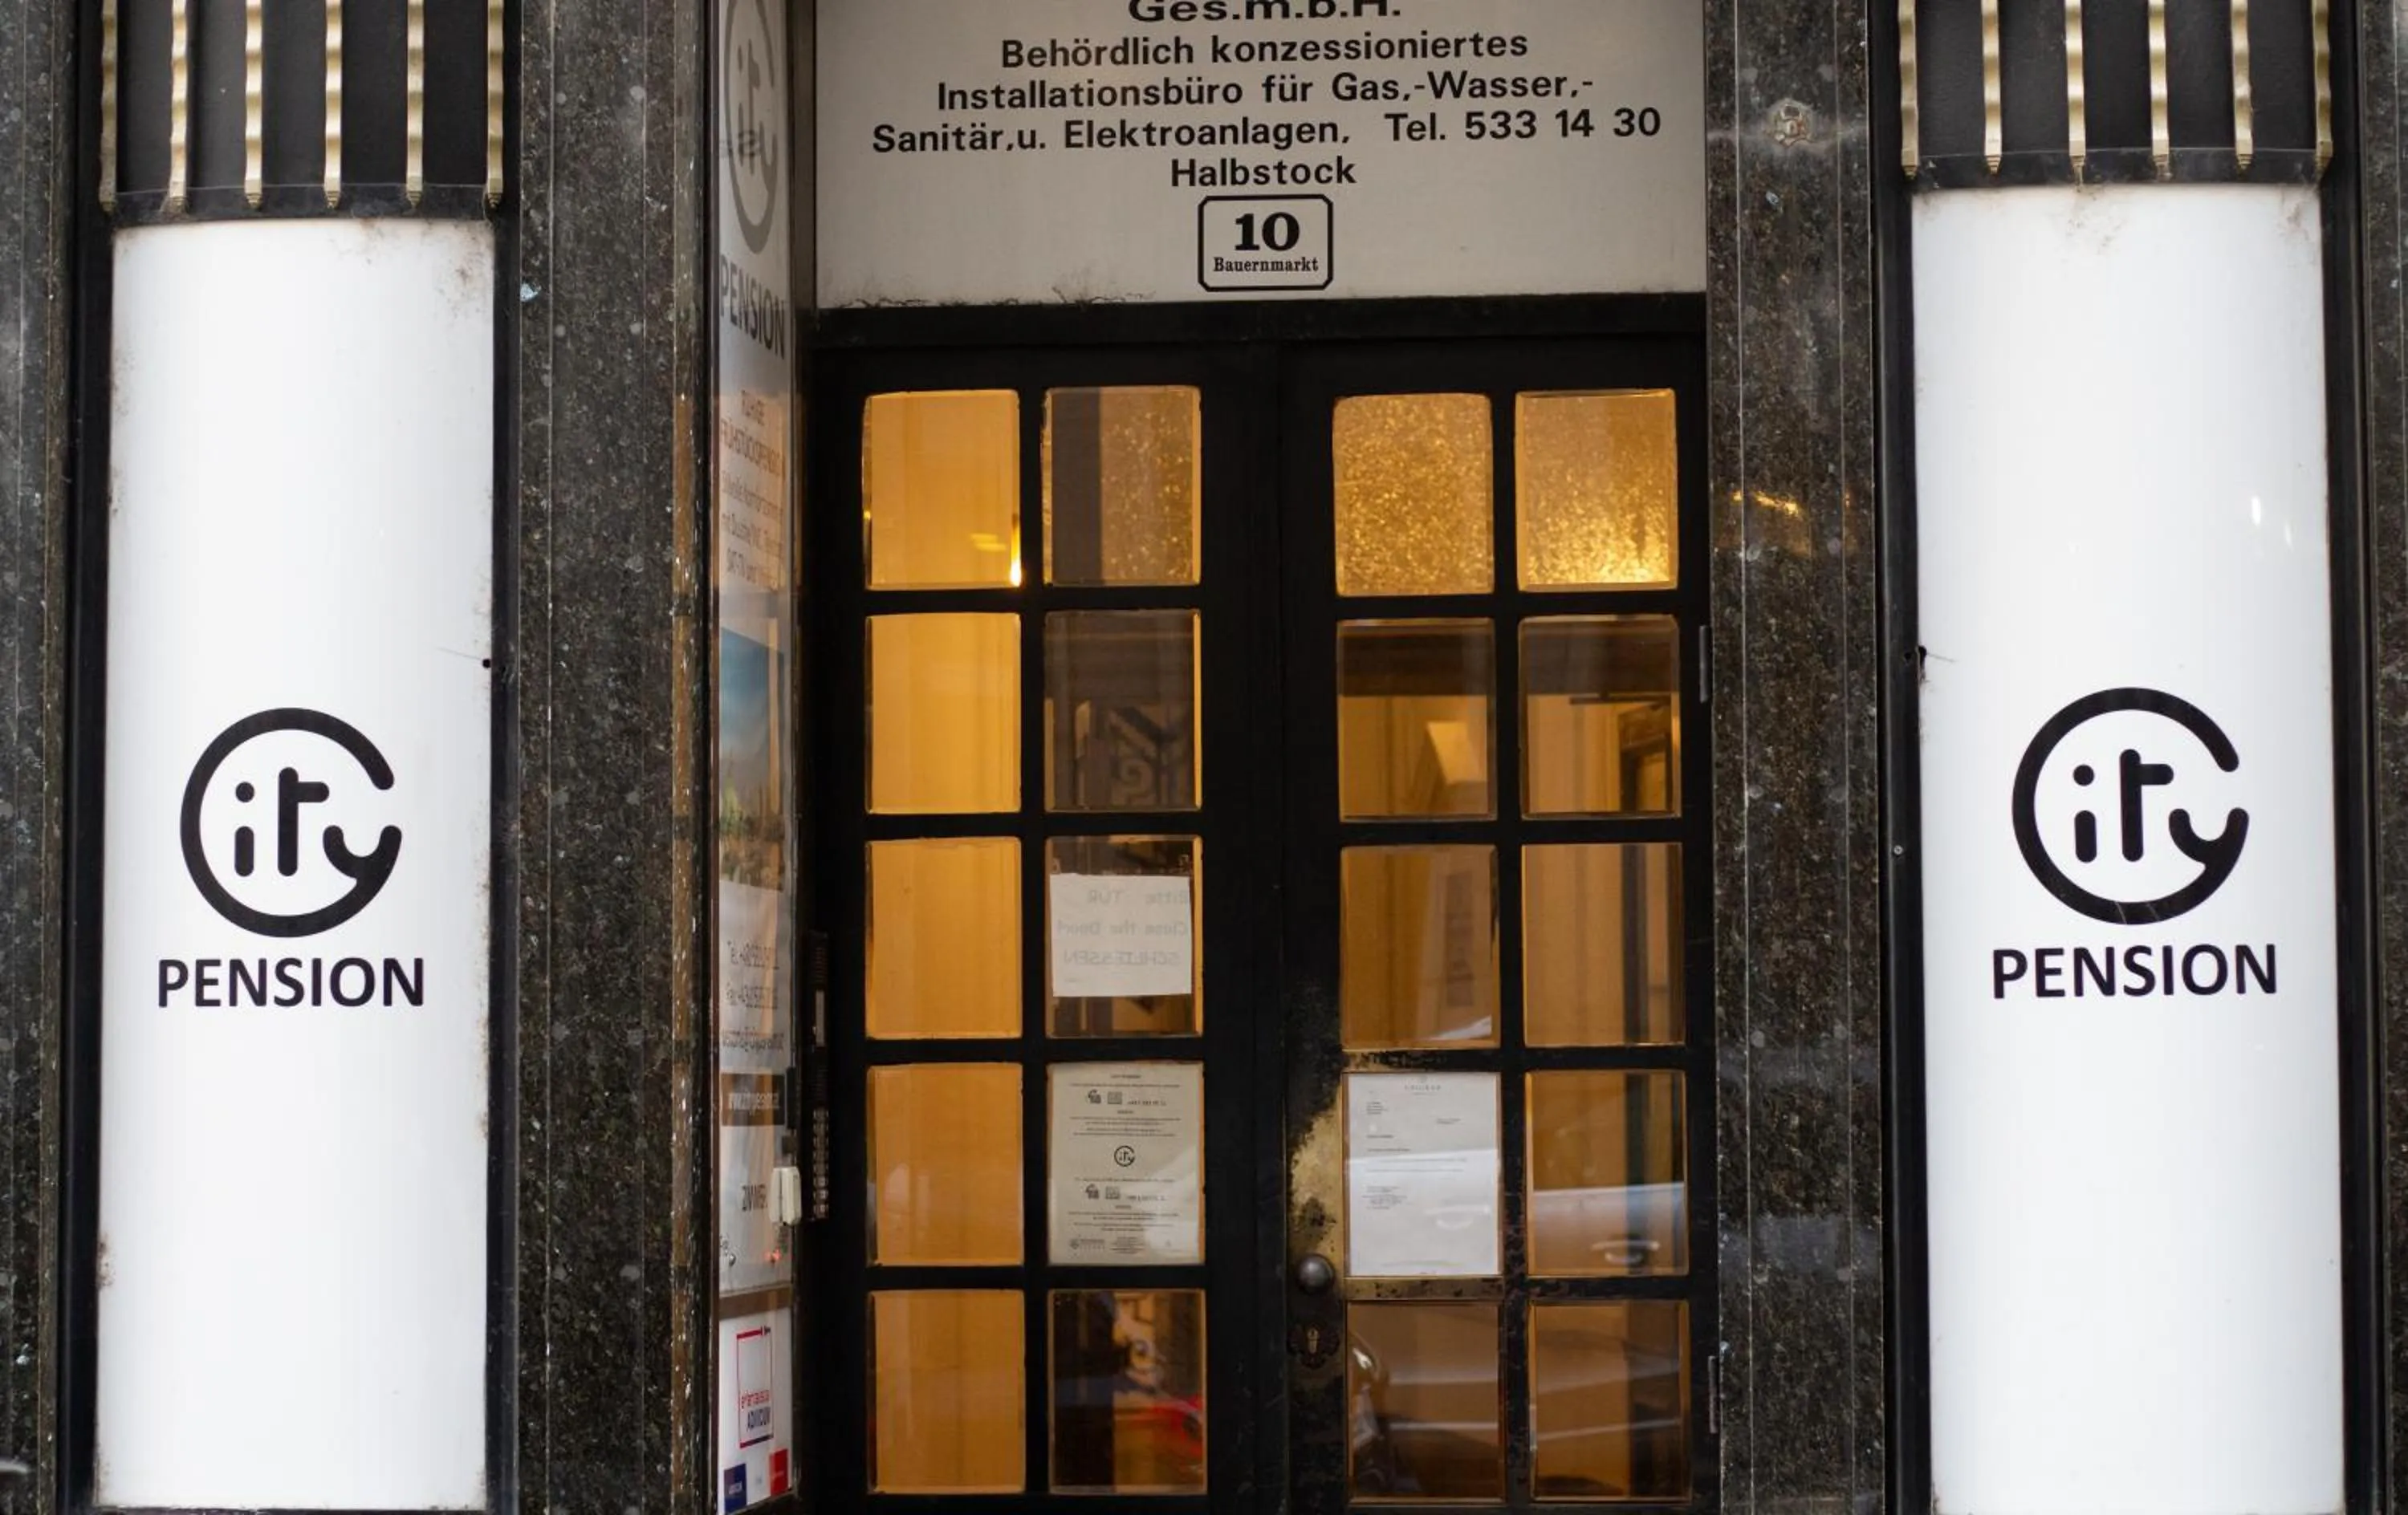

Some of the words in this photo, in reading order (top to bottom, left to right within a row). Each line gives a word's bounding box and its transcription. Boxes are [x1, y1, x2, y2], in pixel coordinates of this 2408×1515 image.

[1128, 0, 1401, 22] Ges.m.b.H.
[1001, 35, 1195, 68] Behördlich
[1211, 30, 1528, 63] konzessioniertes
[938, 76, 1243, 111] Installationsbüro
[1261, 73, 1314, 104] für
[1383, 112, 1447, 142] Tel.
[1465, 109, 1537, 140] 533
[1555, 108, 1596, 139] 14
[1613, 107, 1662, 137] 30
[1171, 155, 1357, 187] Halbstock
[1234, 211, 1300, 252] 10
[1213, 256, 1320, 273] Bauernmarkt
[719, 252, 787, 360] PENSION
[158, 957, 424, 1008] PENSION
[1992, 943, 2277, 999] PENSION
